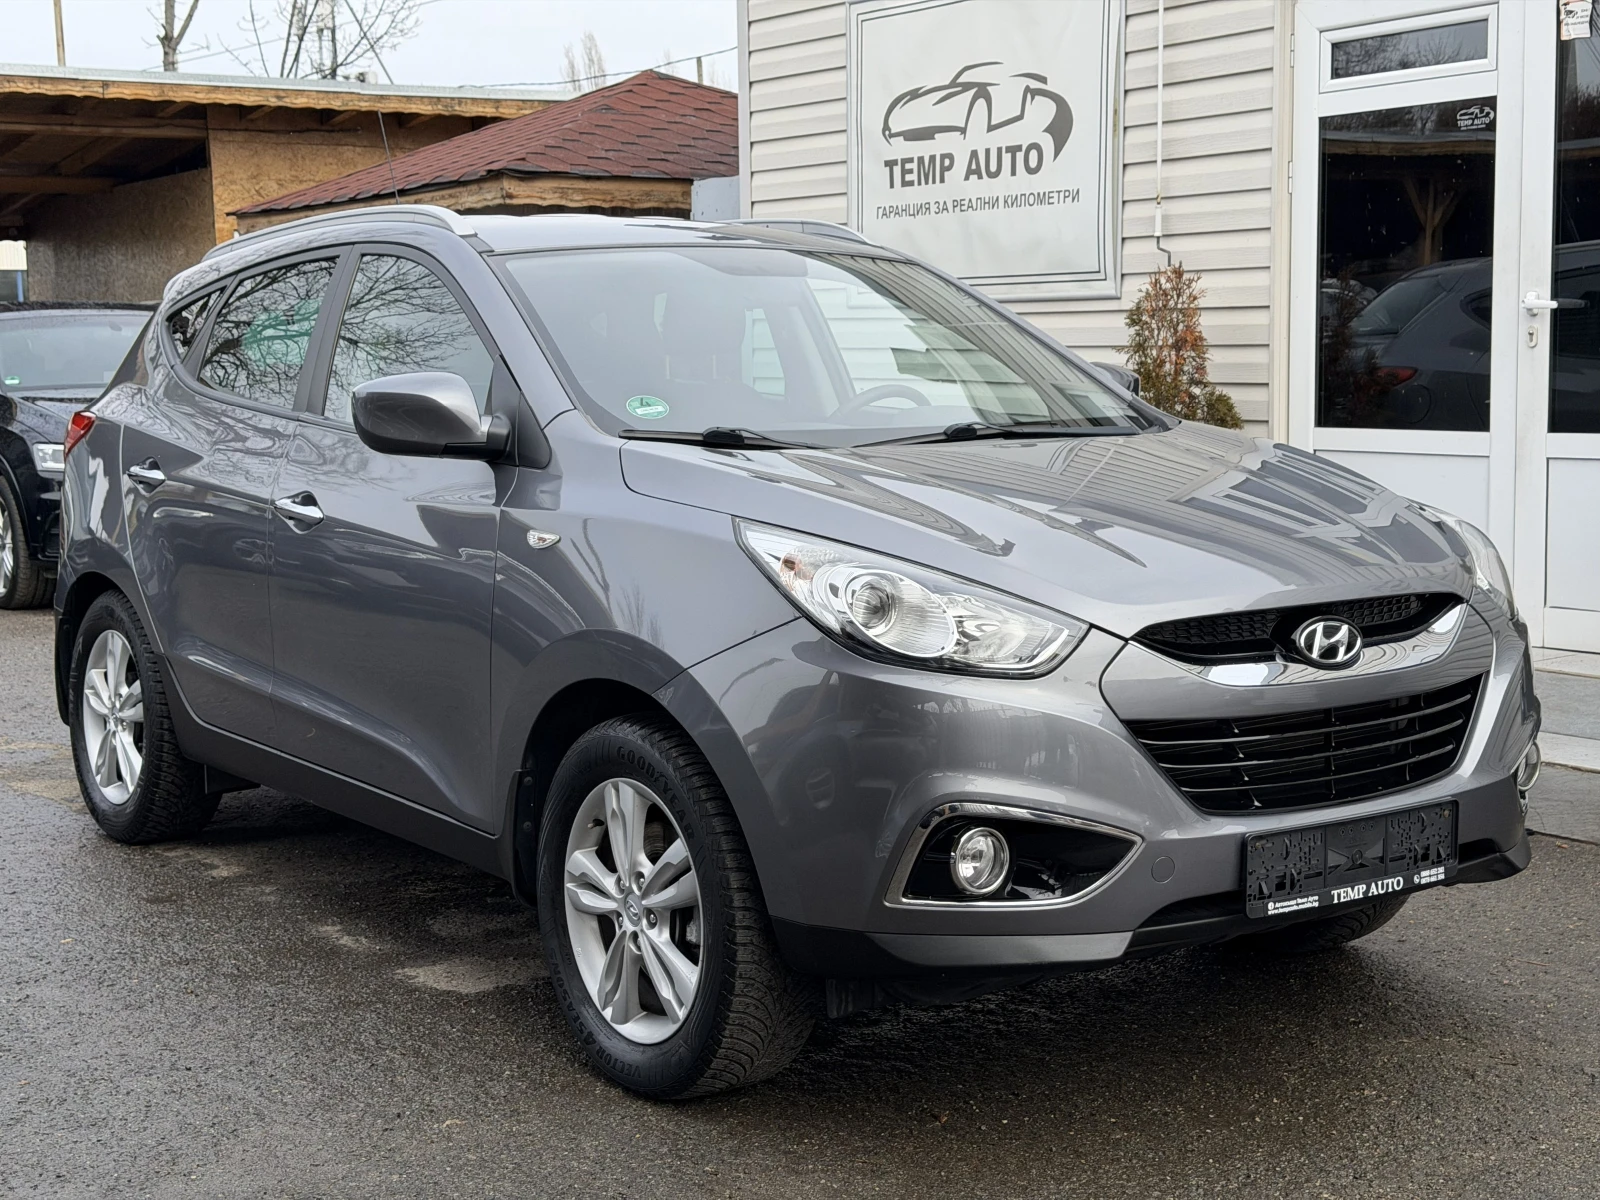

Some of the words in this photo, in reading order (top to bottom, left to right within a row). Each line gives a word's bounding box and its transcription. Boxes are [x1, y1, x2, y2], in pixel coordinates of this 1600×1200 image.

[1474, 117, 1490, 125] AUTO
[883, 152, 955, 190] TEMP
[963, 142, 1044, 182] AUTO
[876, 202, 931, 220] ГАРАНЦИЯ
[934, 200, 950, 216] ЗА
[952, 195, 1000, 213] РЕАЛНИ
[1003, 188, 1081, 209] КИЛОМЕТРИ
[1331, 884, 1367, 904] TEMP
[1368, 876, 1404, 897] AUTO
